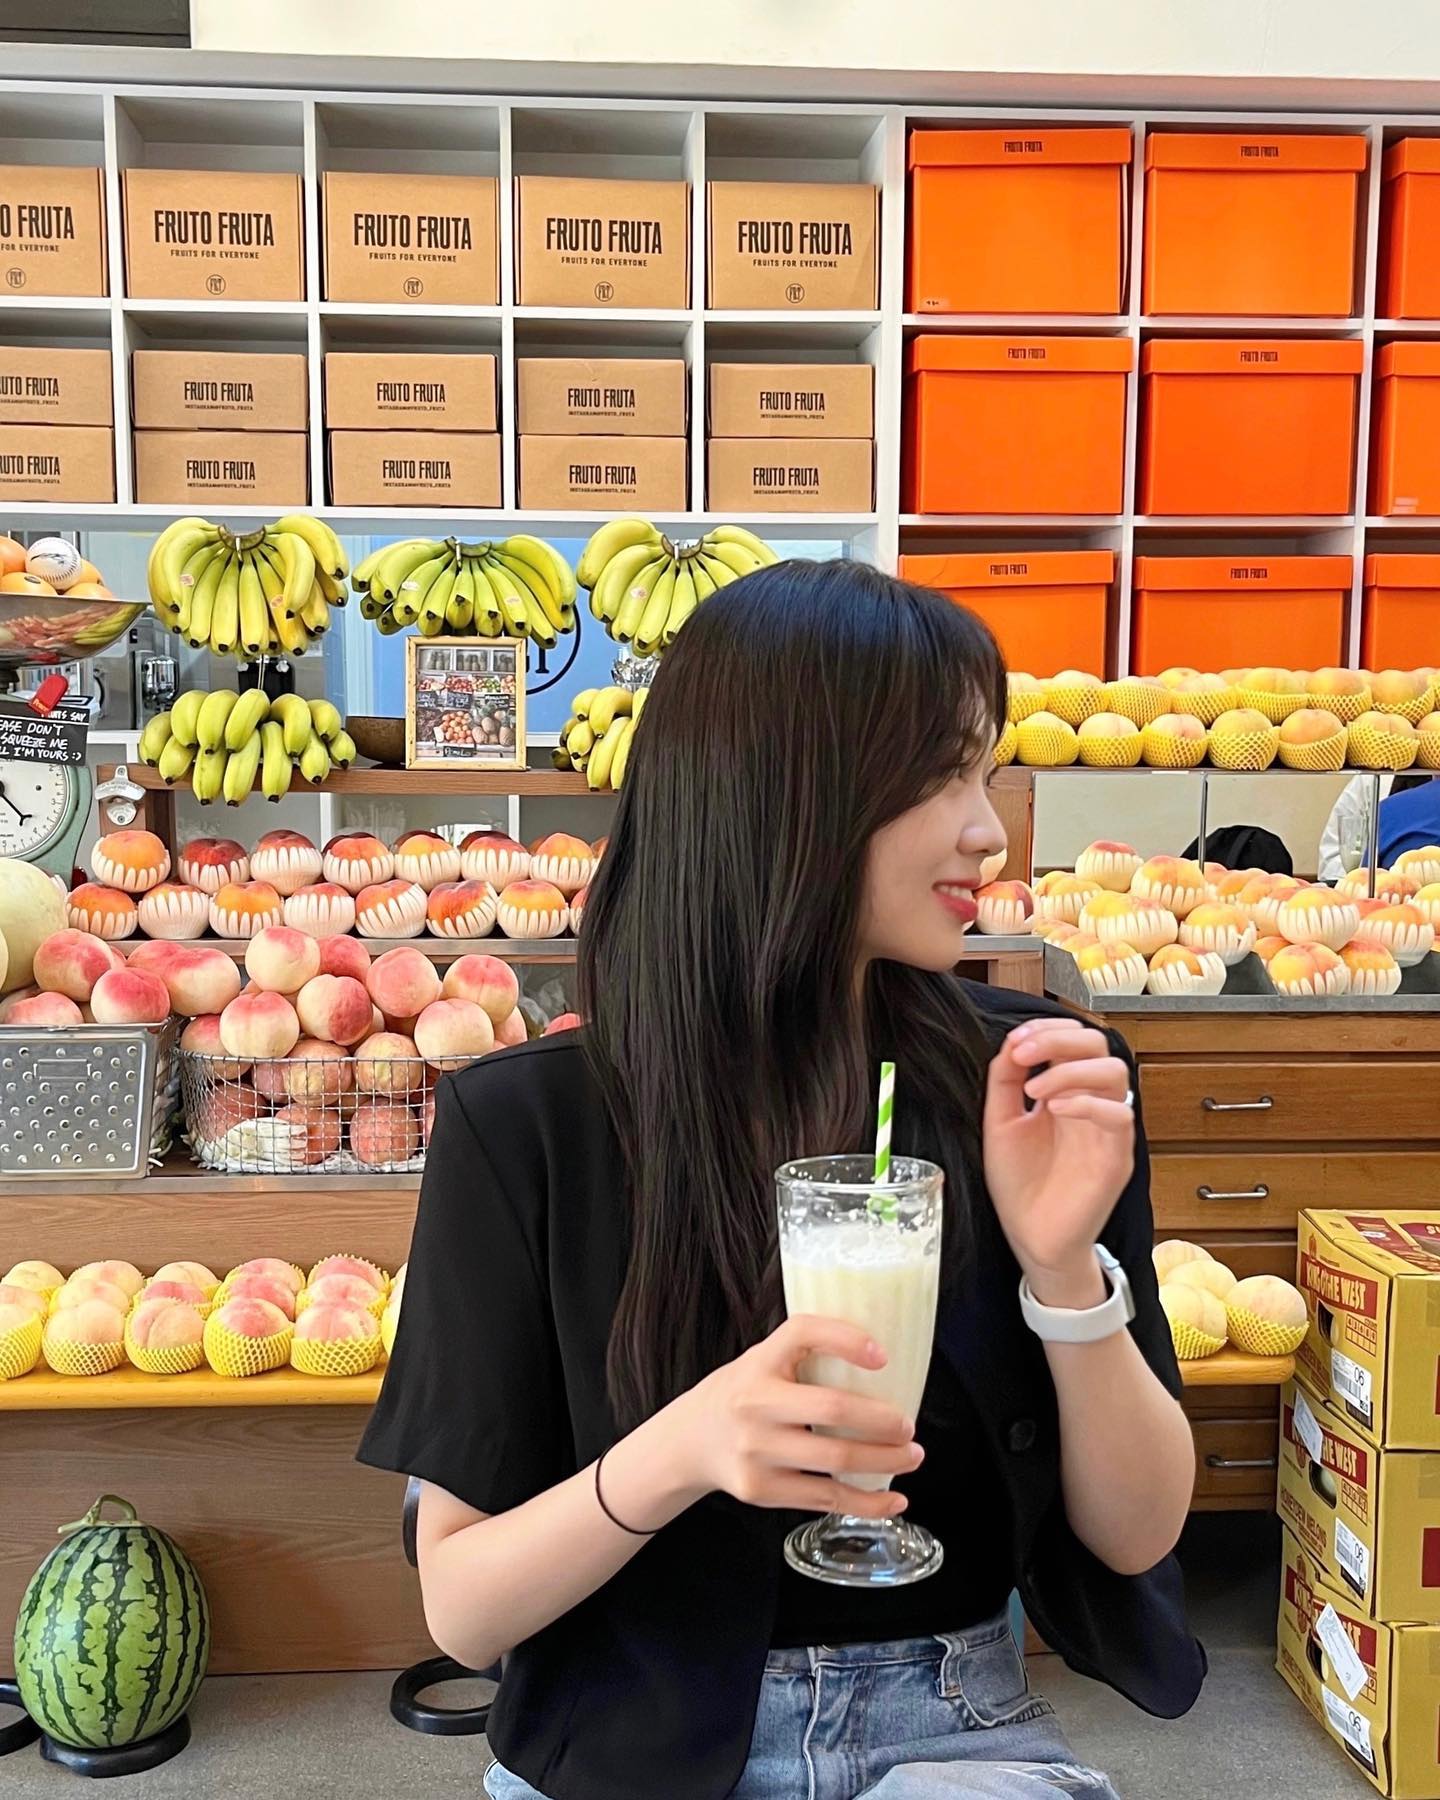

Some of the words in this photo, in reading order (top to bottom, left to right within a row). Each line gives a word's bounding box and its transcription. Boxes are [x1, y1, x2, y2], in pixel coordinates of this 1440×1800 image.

[1004, 141, 1024, 153] FRUTO
[1025, 140, 1043, 153] FRUTA
[1240, 145, 1260, 157] FRUTO
[1260, 146, 1279, 157] FRUTA
[17, 204, 75, 240] FRUTA
[154, 210, 212, 245] FRUTO
[218, 211, 275, 247] FRUTA
[353, 213, 410, 248] FRUTO
[417, 215, 472, 250] FRUTA
[546, 217, 602, 253] FRUTO
[608, 219, 663, 255] FRUTA
[738, 221, 793, 255] FRUTO
[799, 222, 852, 256] FRUTA
[0, 243, 16, 251] FOR
[19, 244, 59, 253] EVERYONE
[170, 249, 198, 258] FRUITS
[201, 250, 217, 258] FOR
[219, 250, 259, 260] EVERYONE
[369, 252, 397, 261] FRUITS
[399, 253, 415, 261] FOR
[417, 253, 457, 263] EVERYONE
[561, 256, 588, 265] FRUITS
[590, 257, 606, 265] FOR
[608, 258, 648, 267] EVERYONE
[752, 258, 780, 267] FRUITS
[782, 259, 797, 267] FOR
[799, 259, 837, 268] EVERYONE
[1007, 347, 1027, 360] FRUTO
[1027, 348, 1046, 359] FRUTA
[1240, 350, 1259, 362] FRUTO
[1260, 351, 1278, 362] FRUTA
[26, 377, 60, 397] FRUTA
[184, 381, 218, 402] FRUTO
[220, 382, 254, 402] FRUTA
[376, 382, 410, 402] FRUTO
[413, 383, 446, 403] FRUTA
[567, 387, 601, 408] FRUTO
[603, 388, 636, 409] FRUTA
[759, 391, 792, 411] FRUTO
[794, 392, 826, 412] FRUTA
[27, 456, 61, 476] FRUTA
[186, 459, 220, 480] FRUTO
[223, 460, 256, 481] FRUTA
[382, 459, 416, 479] FRUTO
[418, 460, 452, 480] FRUTA
[569, 464, 602, 485] FRUTO
[604, 465, 637, 485] FRUTA
[753, 467, 786, 487] FRUTO
[788, 467, 820, 487] FRUTA
[990, 565, 1009, 576] FRUTO
[1009, 563, 1028, 575] FRUTA
[1230, 568, 1249, 579] FRUTO
[1249, 568, 1268, 579] FRUTA
[70, 711, 87, 722] SAY
[26, 722, 64, 736] DON'T
[0, 732, 47, 748] SQUEEZE
[49, 738, 68, 750] ME
[13, 747, 35, 757] I'M
[37, 748, 69, 761] YOURS
[1354, 1367, 1365, 1386] 06
[1348, 1711, 1362, 1732] 06
